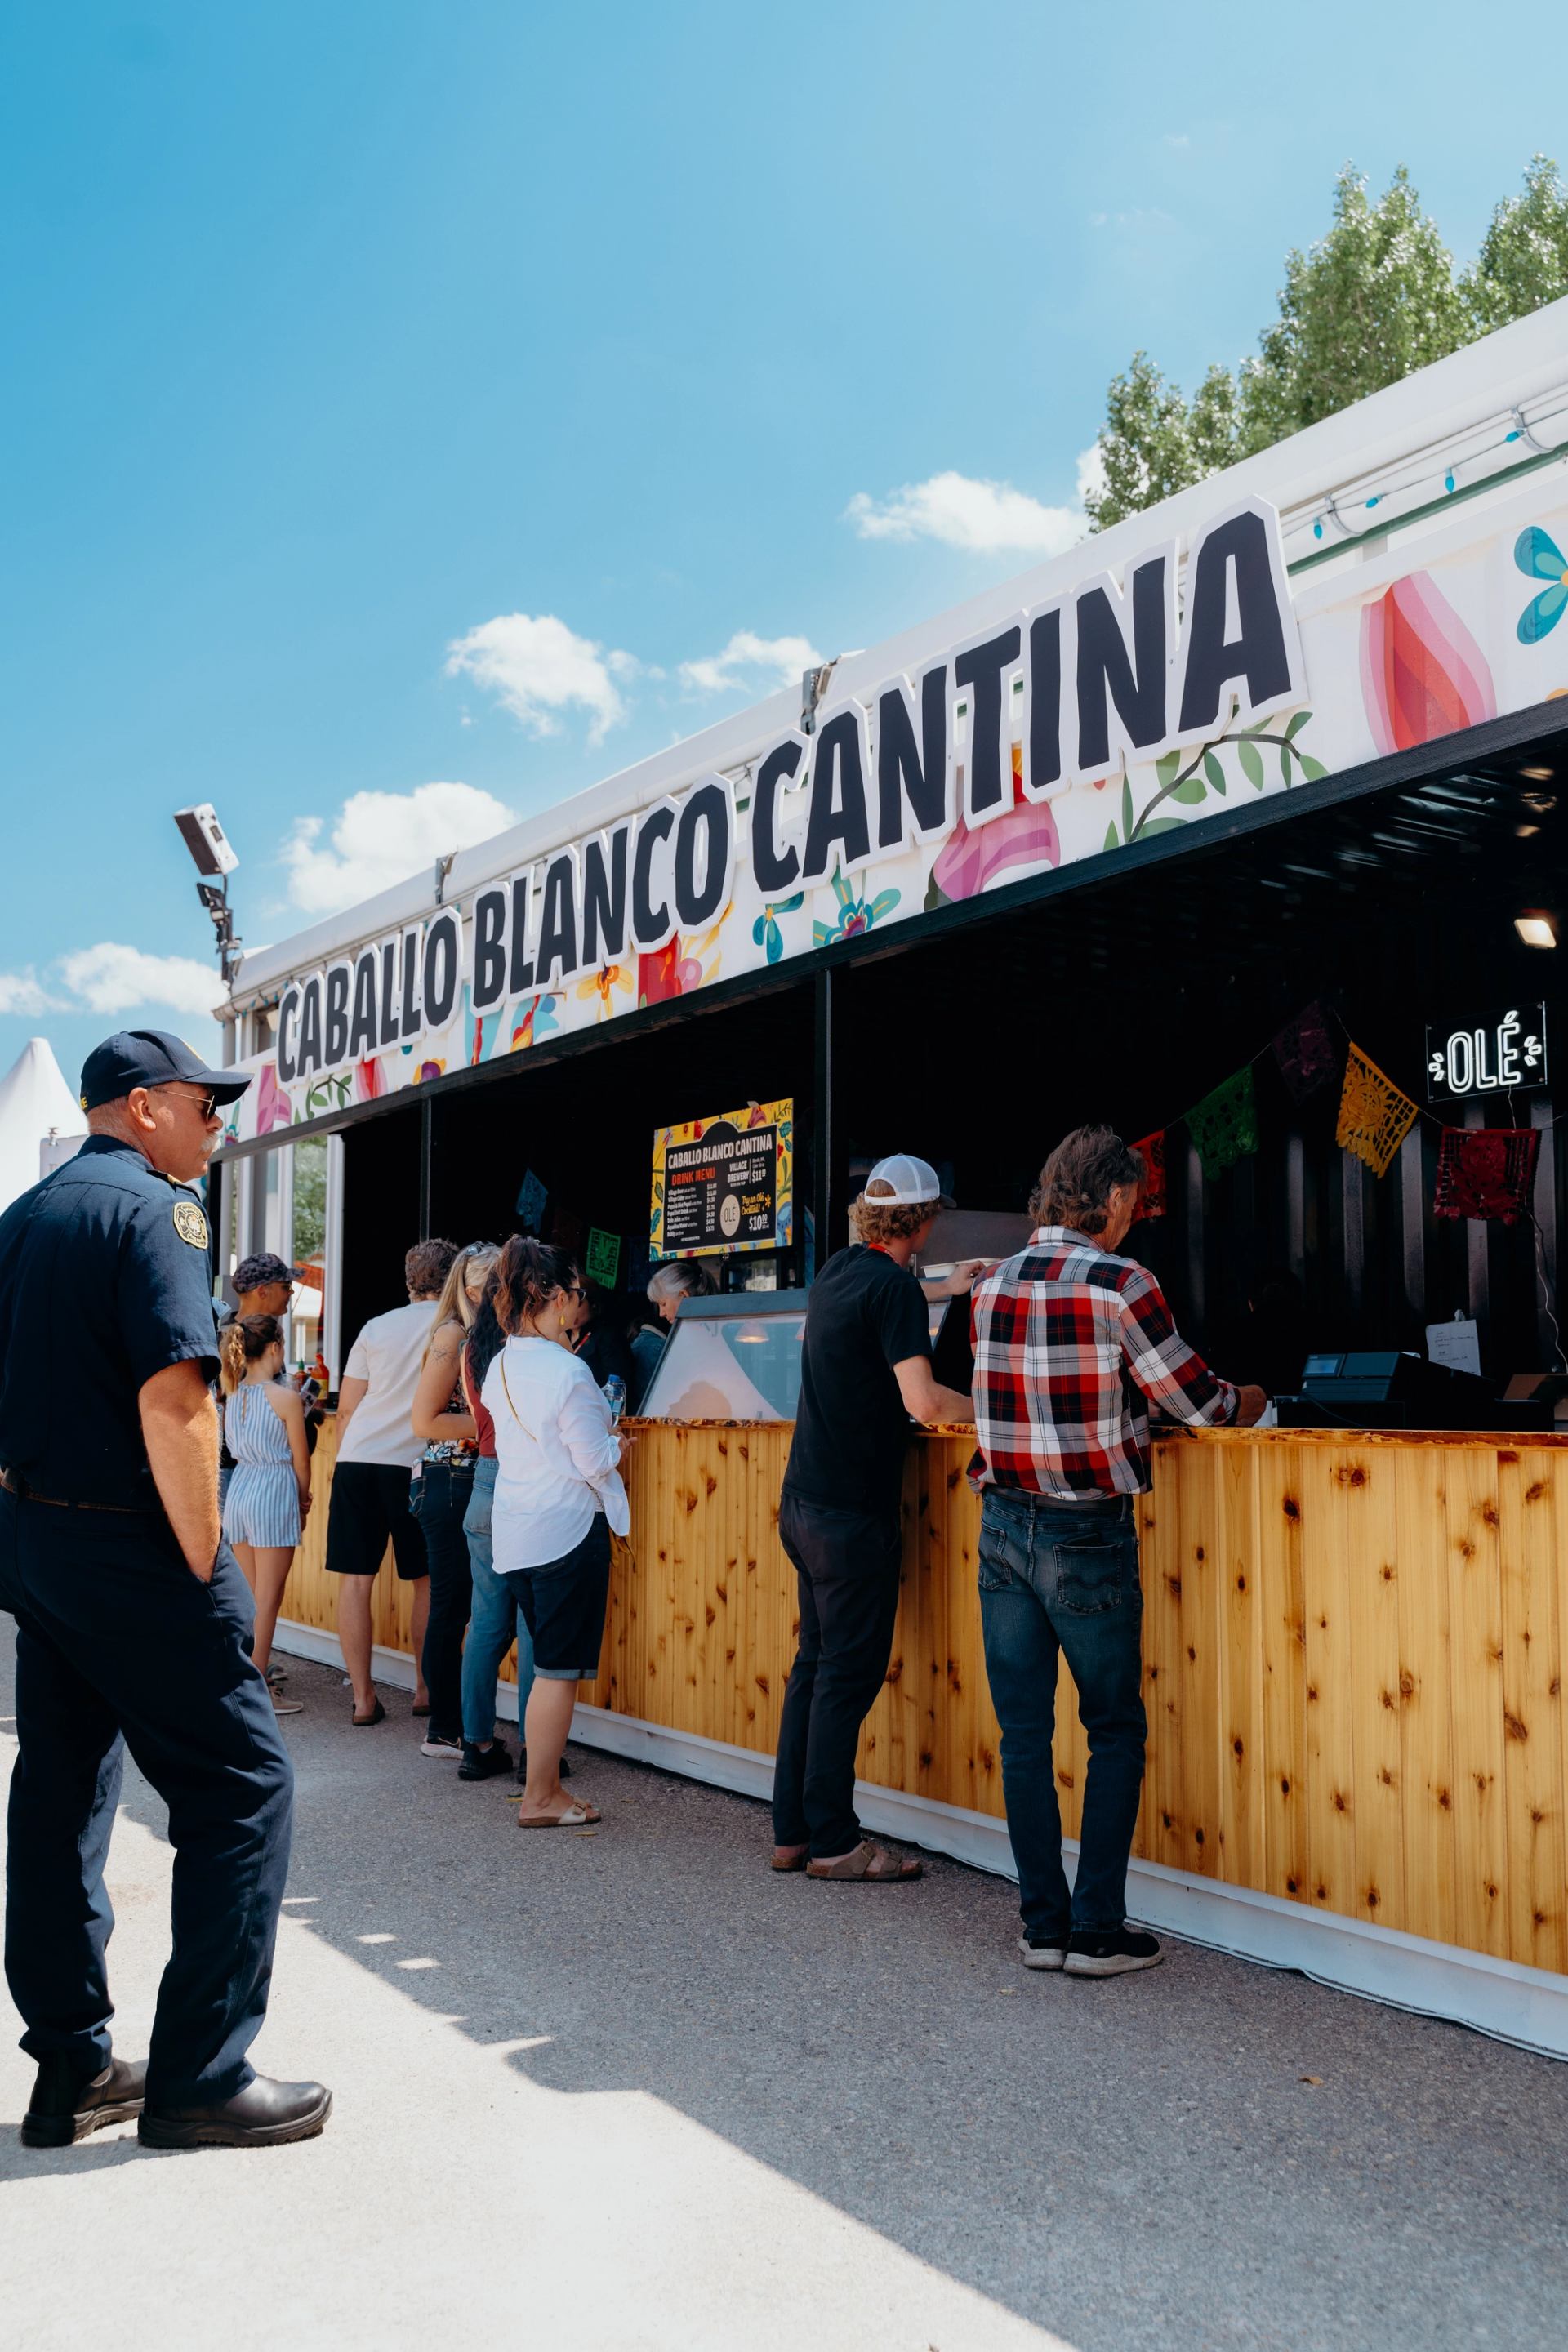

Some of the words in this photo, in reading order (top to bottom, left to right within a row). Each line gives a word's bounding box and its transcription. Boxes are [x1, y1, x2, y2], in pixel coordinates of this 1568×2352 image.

[278, 915, 459, 1083] CABALLO
[472, 783, 729, 1009] BLANCO
[751, 510, 1292, 893] CANTINA
[1447, 1009, 1523, 1094] OLÉ
[668, 1148, 702, 1169] CABALLO
[702, 1142, 734, 1163] BLANCO
[735, 1134, 773, 1156] CANTINA
[729, 1160, 747, 1172] VILLAGE
[671, 1172, 693, 1186] DRINK
[695, 1166, 715, 1181] MENU
